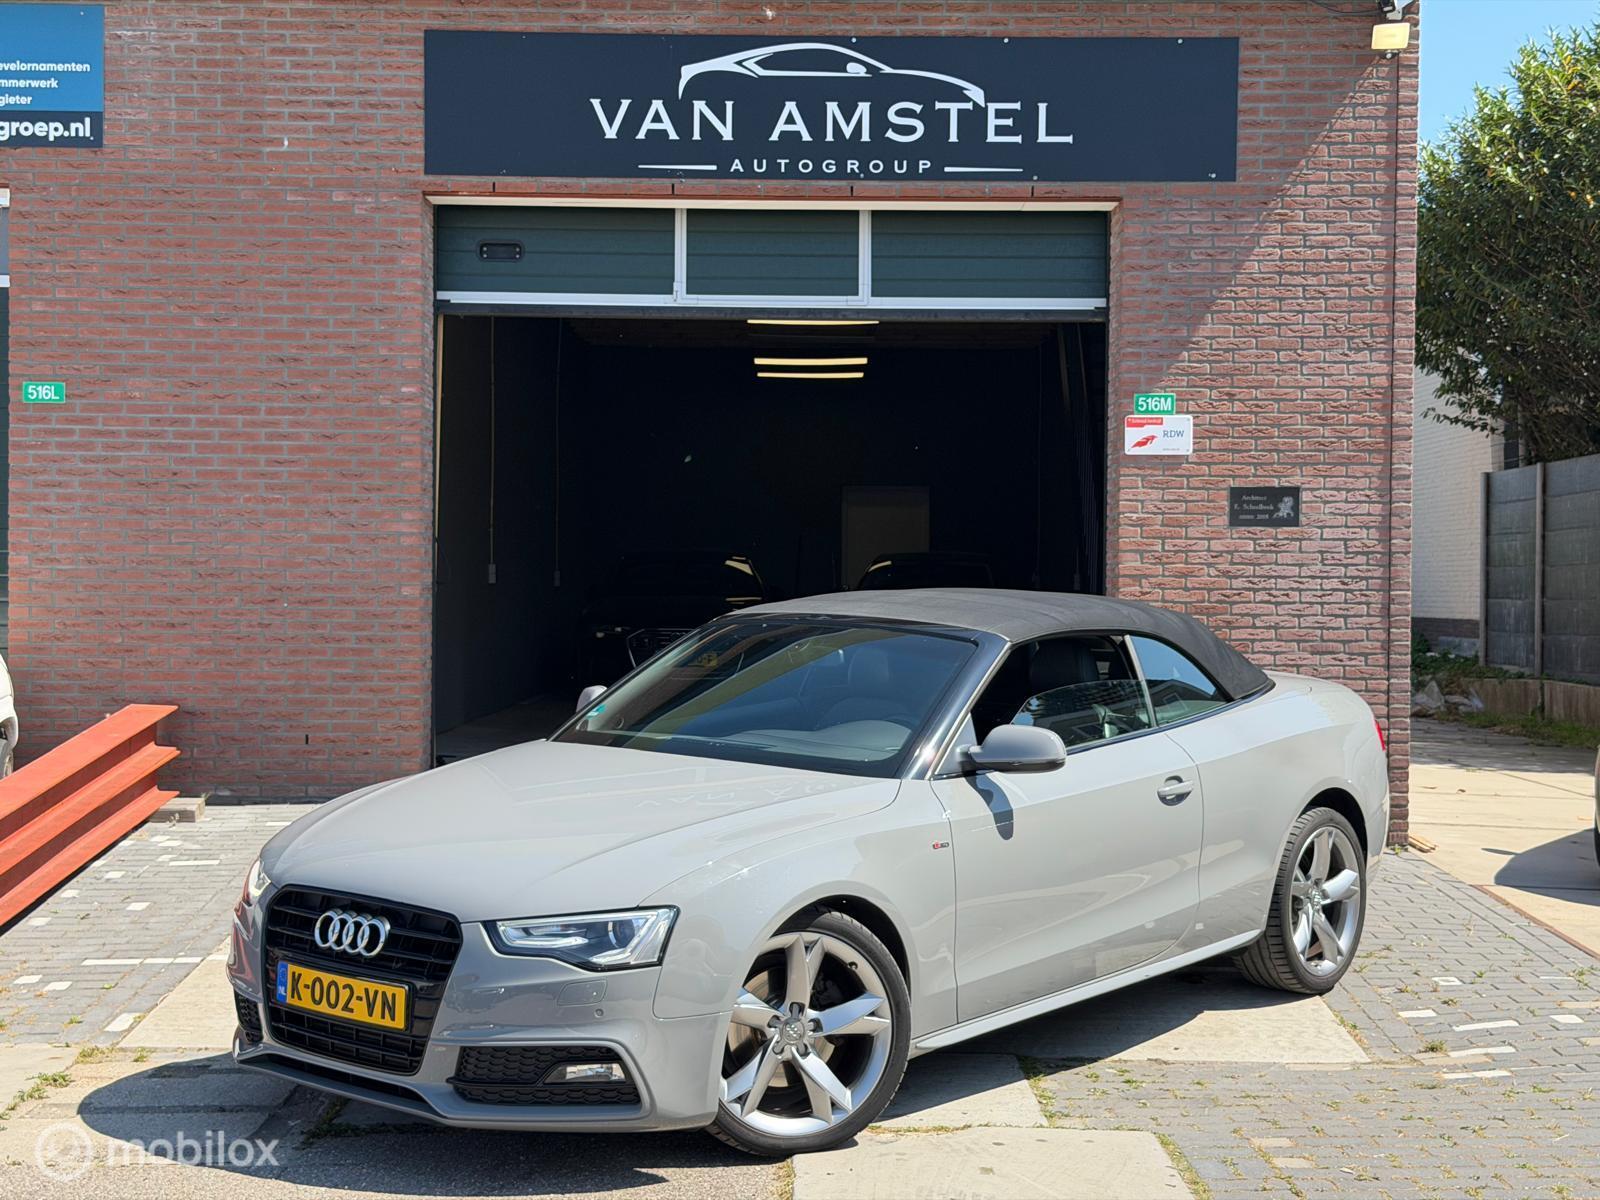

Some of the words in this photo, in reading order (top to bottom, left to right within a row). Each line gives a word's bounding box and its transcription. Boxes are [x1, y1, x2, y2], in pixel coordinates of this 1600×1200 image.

[0, 117, 91, 141] groep.nl
[590, 98, 735, 142] VAN
[768, 100, 1074, 145] AMSTEL
[729, 158, 933, 174] AUTOGROUP
[27, 384, 60, 400] 516L
[1137, 396, 1172, 412] 516M
[1162, 430, 1185, 438] RDW
[290, 970, 397, 1022] K-002-VN
